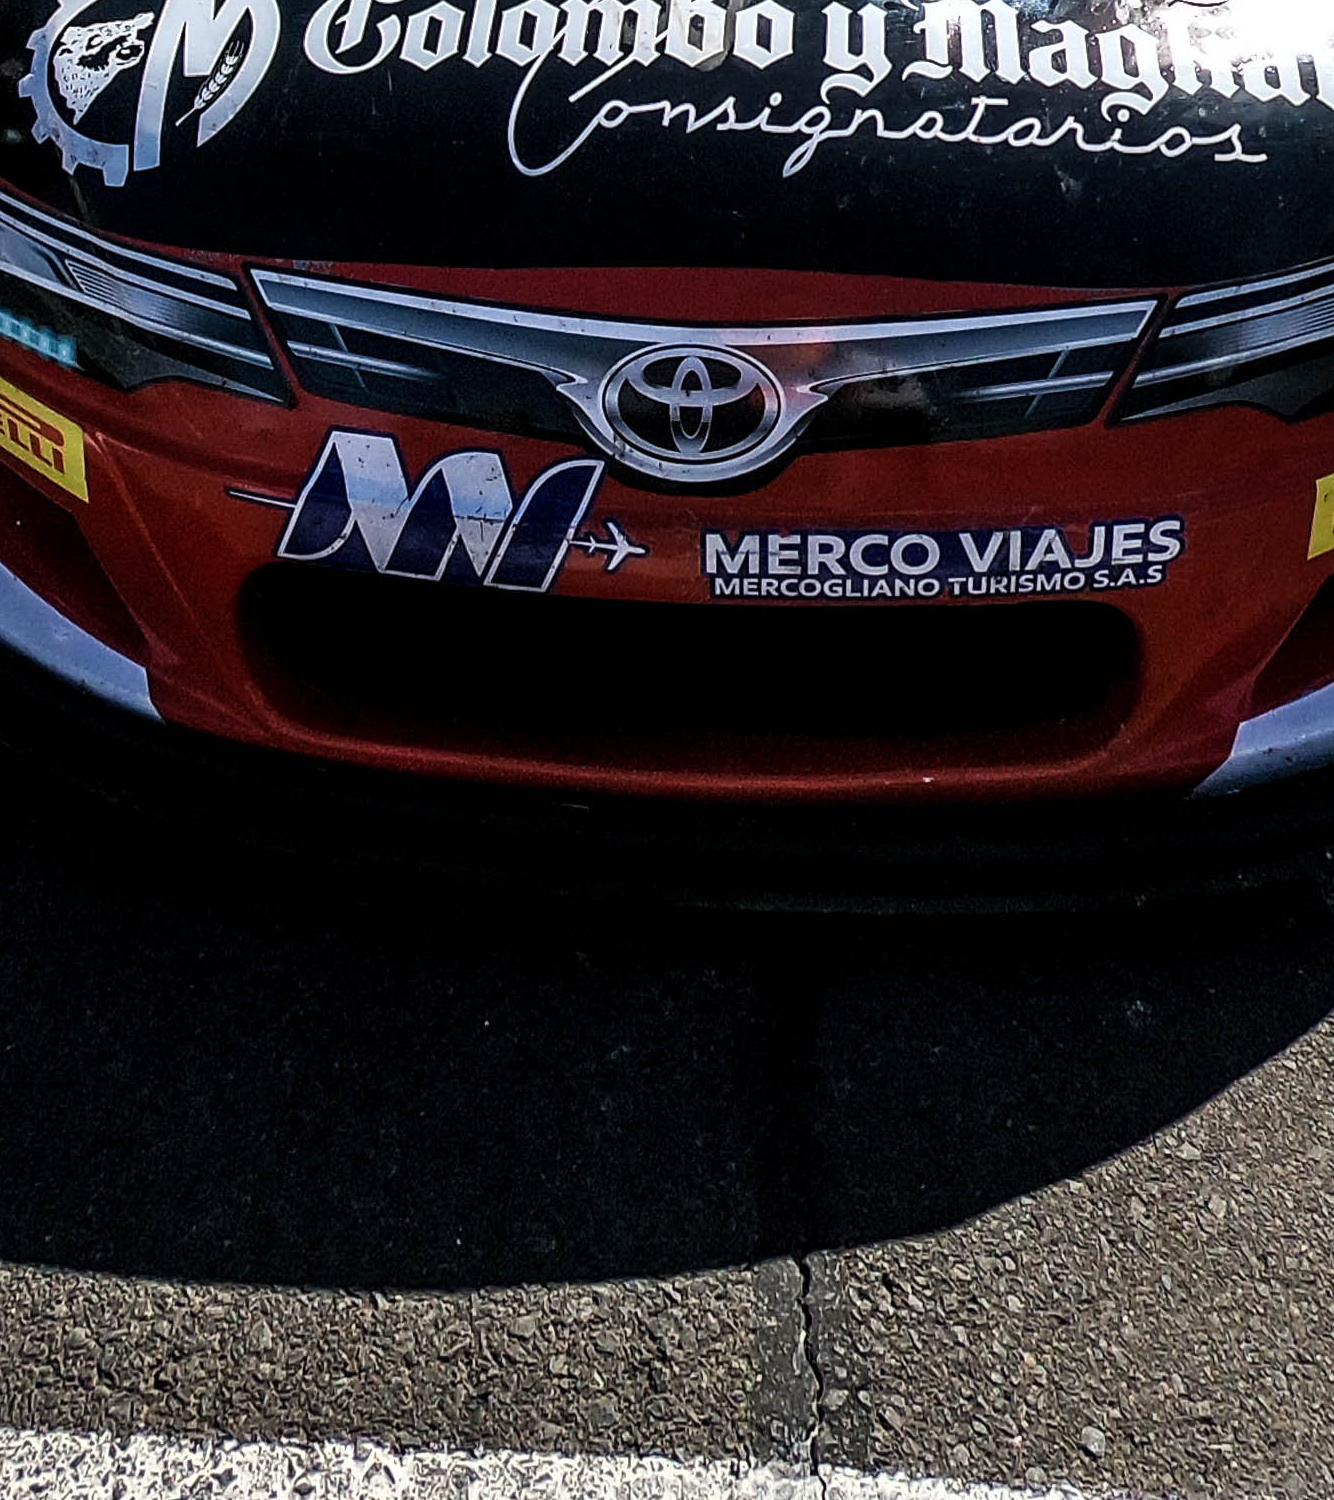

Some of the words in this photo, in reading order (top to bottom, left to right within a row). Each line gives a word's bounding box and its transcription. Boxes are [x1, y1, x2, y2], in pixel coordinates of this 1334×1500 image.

[821, 0, 894, 99] y
[705, 531, 941, 577] MERCO
[958, 520, 1184, 573] VIAJES
[713, 576, 941, 598] MERCOGLIANO
[948, 570, 1088, 596] TURISMO
[1092, 563, 1164, 590] S.A.S
